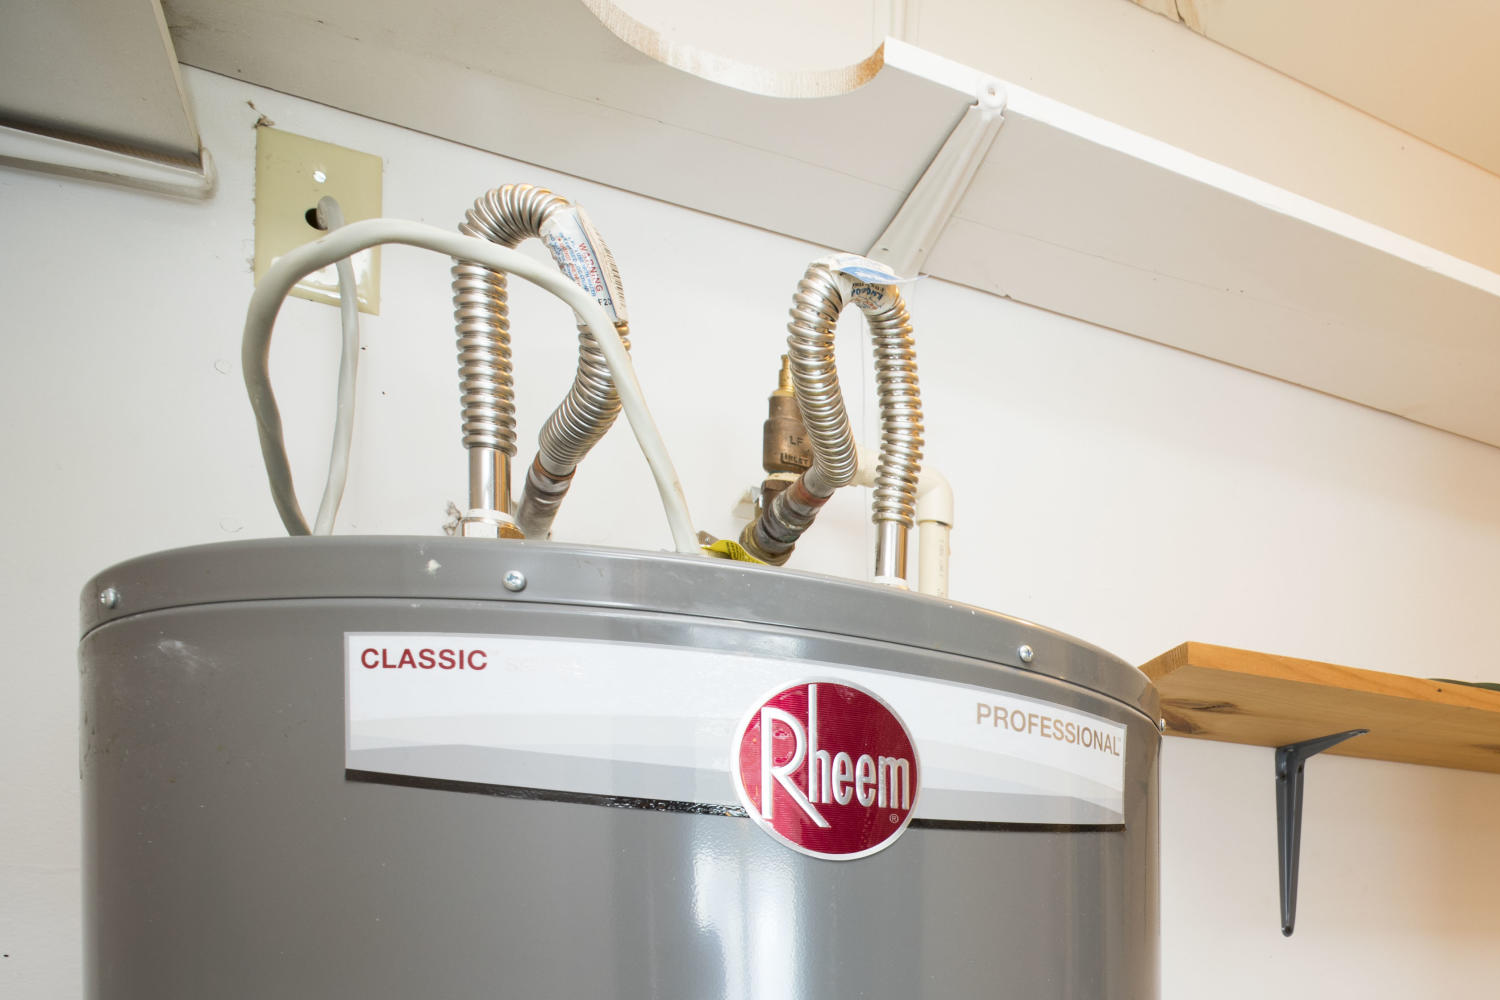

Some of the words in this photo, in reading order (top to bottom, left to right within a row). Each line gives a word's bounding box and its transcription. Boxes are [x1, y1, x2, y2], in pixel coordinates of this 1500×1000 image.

[579, 242, 603, 292] WARNING
[361, 648, 487, 670] CLASSIC
[976, 702, 1120, 756] PROFESSIONAL
[760, 683, 910, 828] Rheem
